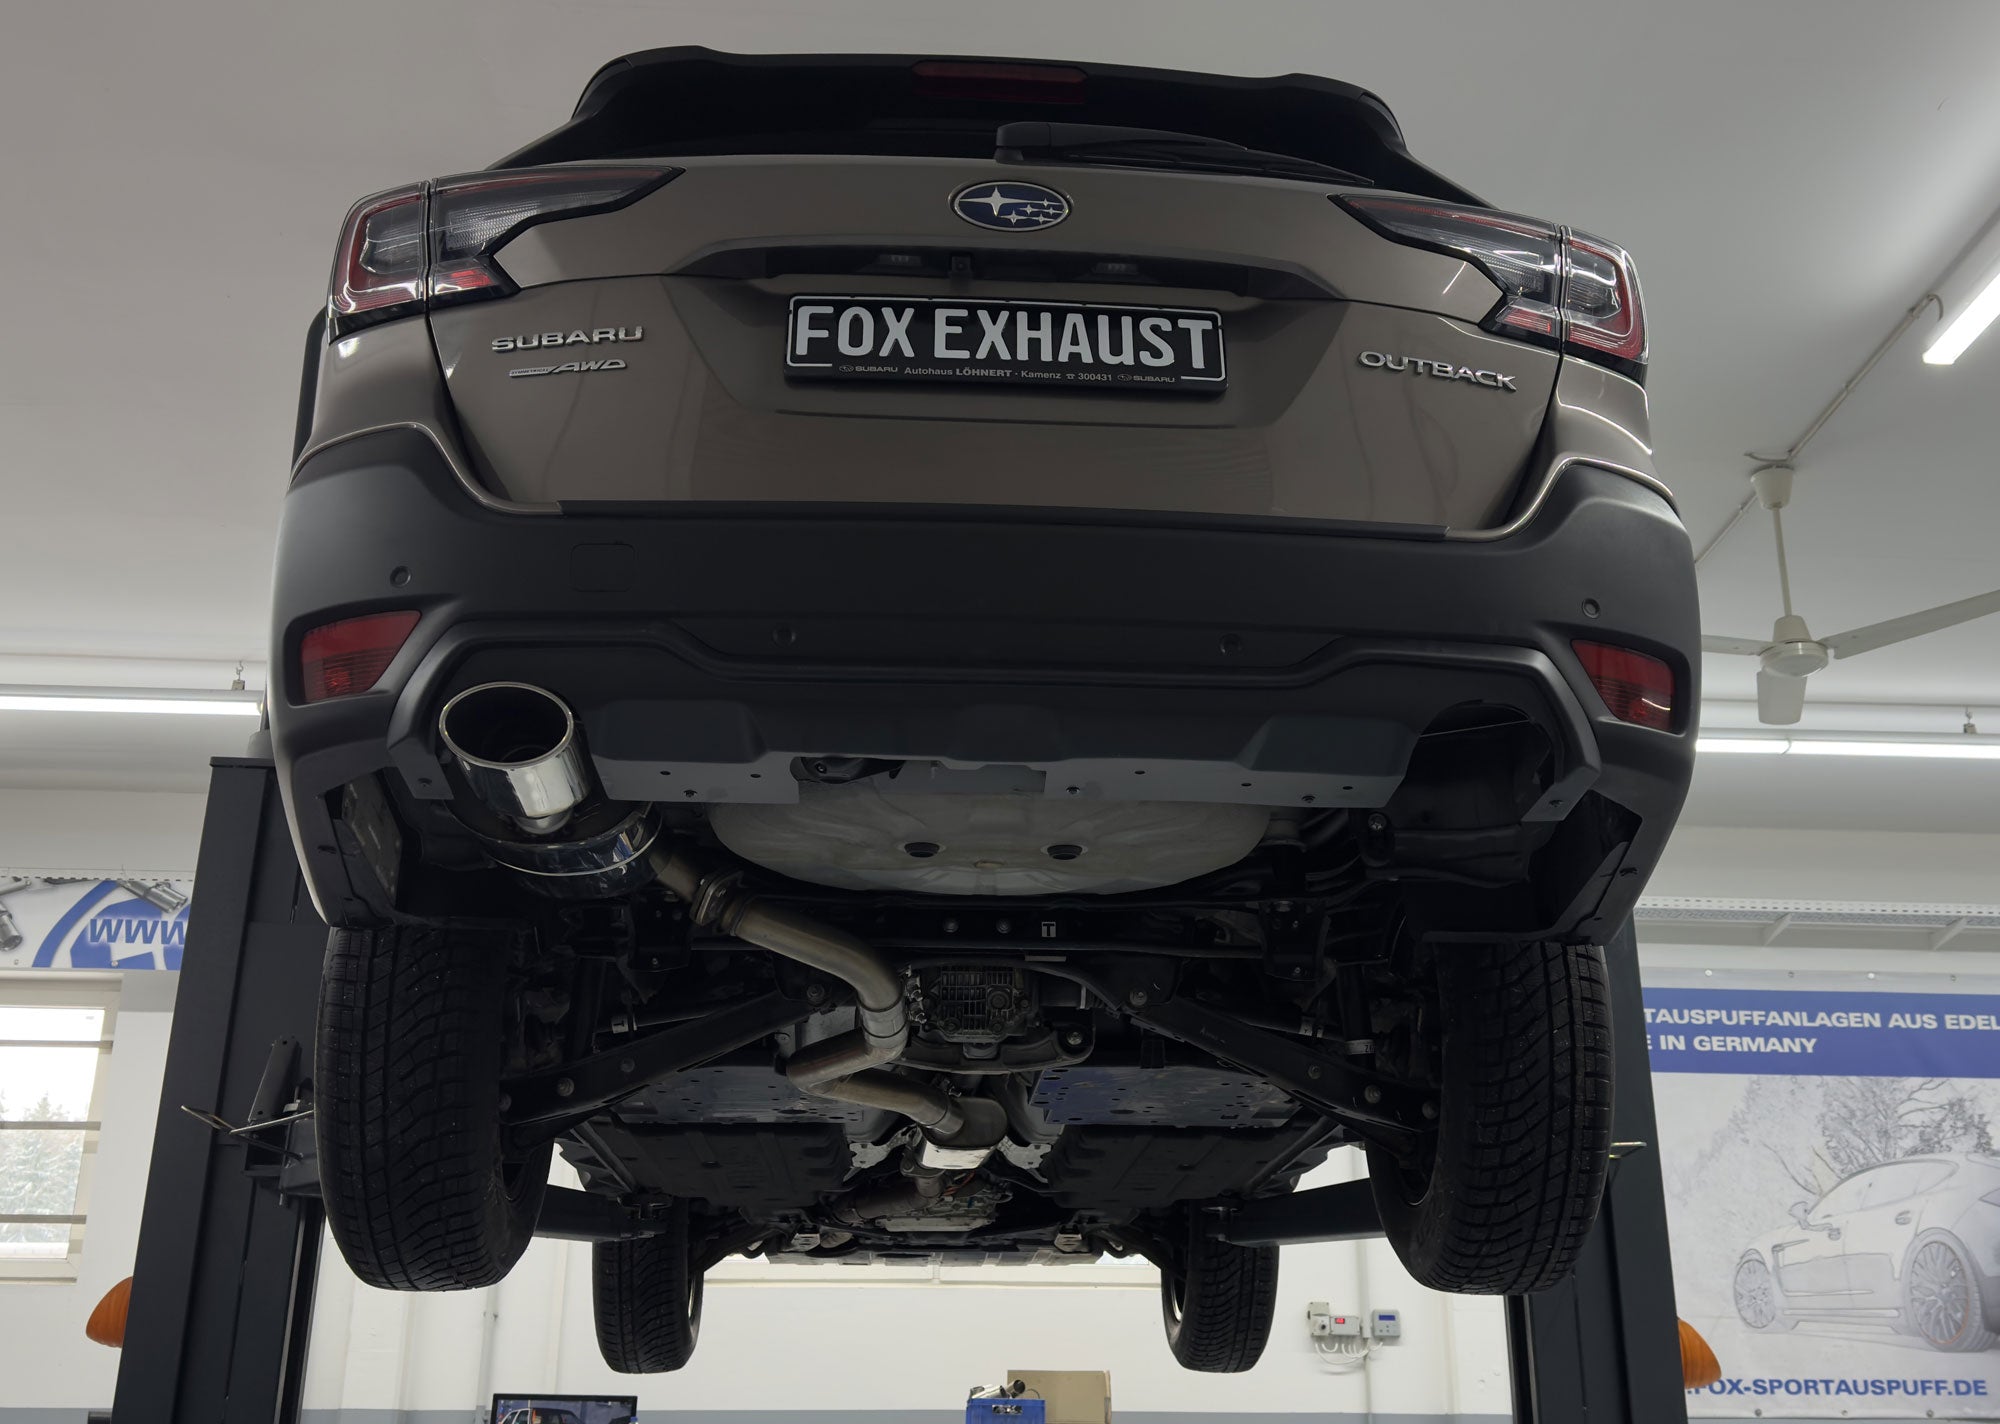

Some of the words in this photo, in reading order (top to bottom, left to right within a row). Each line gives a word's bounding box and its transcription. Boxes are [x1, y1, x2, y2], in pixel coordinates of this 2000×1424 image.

[491, 326, 643, 352] SUBARU
[795, 306, 915, 357] FOX
[933, 308, 1213, 369] EXHAUST
[552, 358, 627, 373] AWD
[855, 365, 898, 373] SUBARU
[904, 366, 953, 376] Autohaus
[955, 367, 1013, 377] LÖHNERT
[1021, 370, 1061, 379] Kamenz
[1078, 373, 1112, 381] 300431
[1133, 375, 1175, 383] SUBARU
[1359, 351, 1517, 392] OUTBACK
[1043, 923, 1055, 936] T
[1643, 1008, 1881, 1028] TAUSPUFFANLAGEN
[1888, 1012, 1938, 1029] AUS
[1944, 1013, 2000, 1031] EDEL
[1659, 1034, 1686, 1051] IN
[1693, 1036, 1818, 1053] GERMANY
